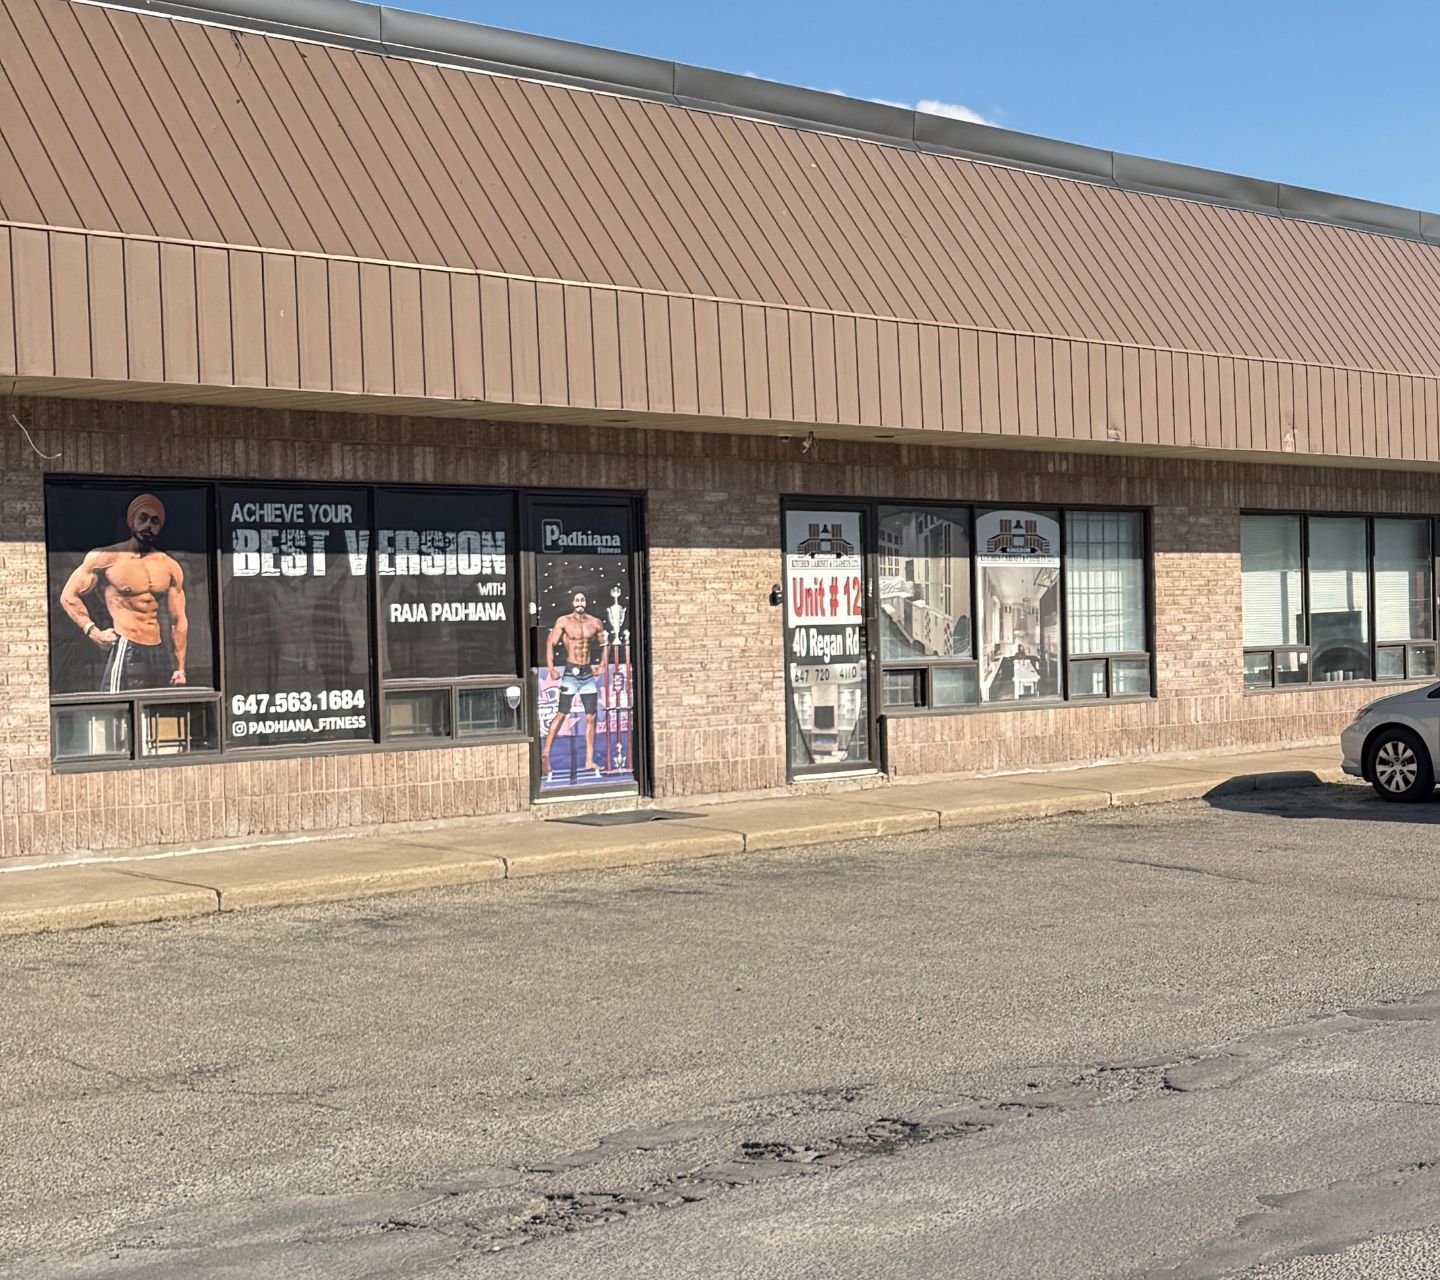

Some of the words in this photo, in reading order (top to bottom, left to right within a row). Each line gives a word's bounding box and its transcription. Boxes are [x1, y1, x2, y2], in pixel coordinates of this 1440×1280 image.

[231, 503, 304, 523] ACHIEVE
[308, 504, 353, 523] YOUR
[545, 524, 621, 546] Padhiana
[232, 529, 330, 577] BEST
[477, 582, 506, 596] WITH
[793, 577, 826, 617] Unit
[829, 576, 839, 617] #
[844, 576, 861, 616] 12
[390, 603, 429, 622] RAJA
[432, 602, 507, 622] PADHIANA
[792, 628, 807, 657] 40
[809, 628, 843, 663] Regan
[845, 626, 860, 655] Rd
[815, 668, 830, 681] 720
[231, 689, 366, 715] 647.563.1684
[248, 715, 367, 735] PADHIANA_FITNESS
